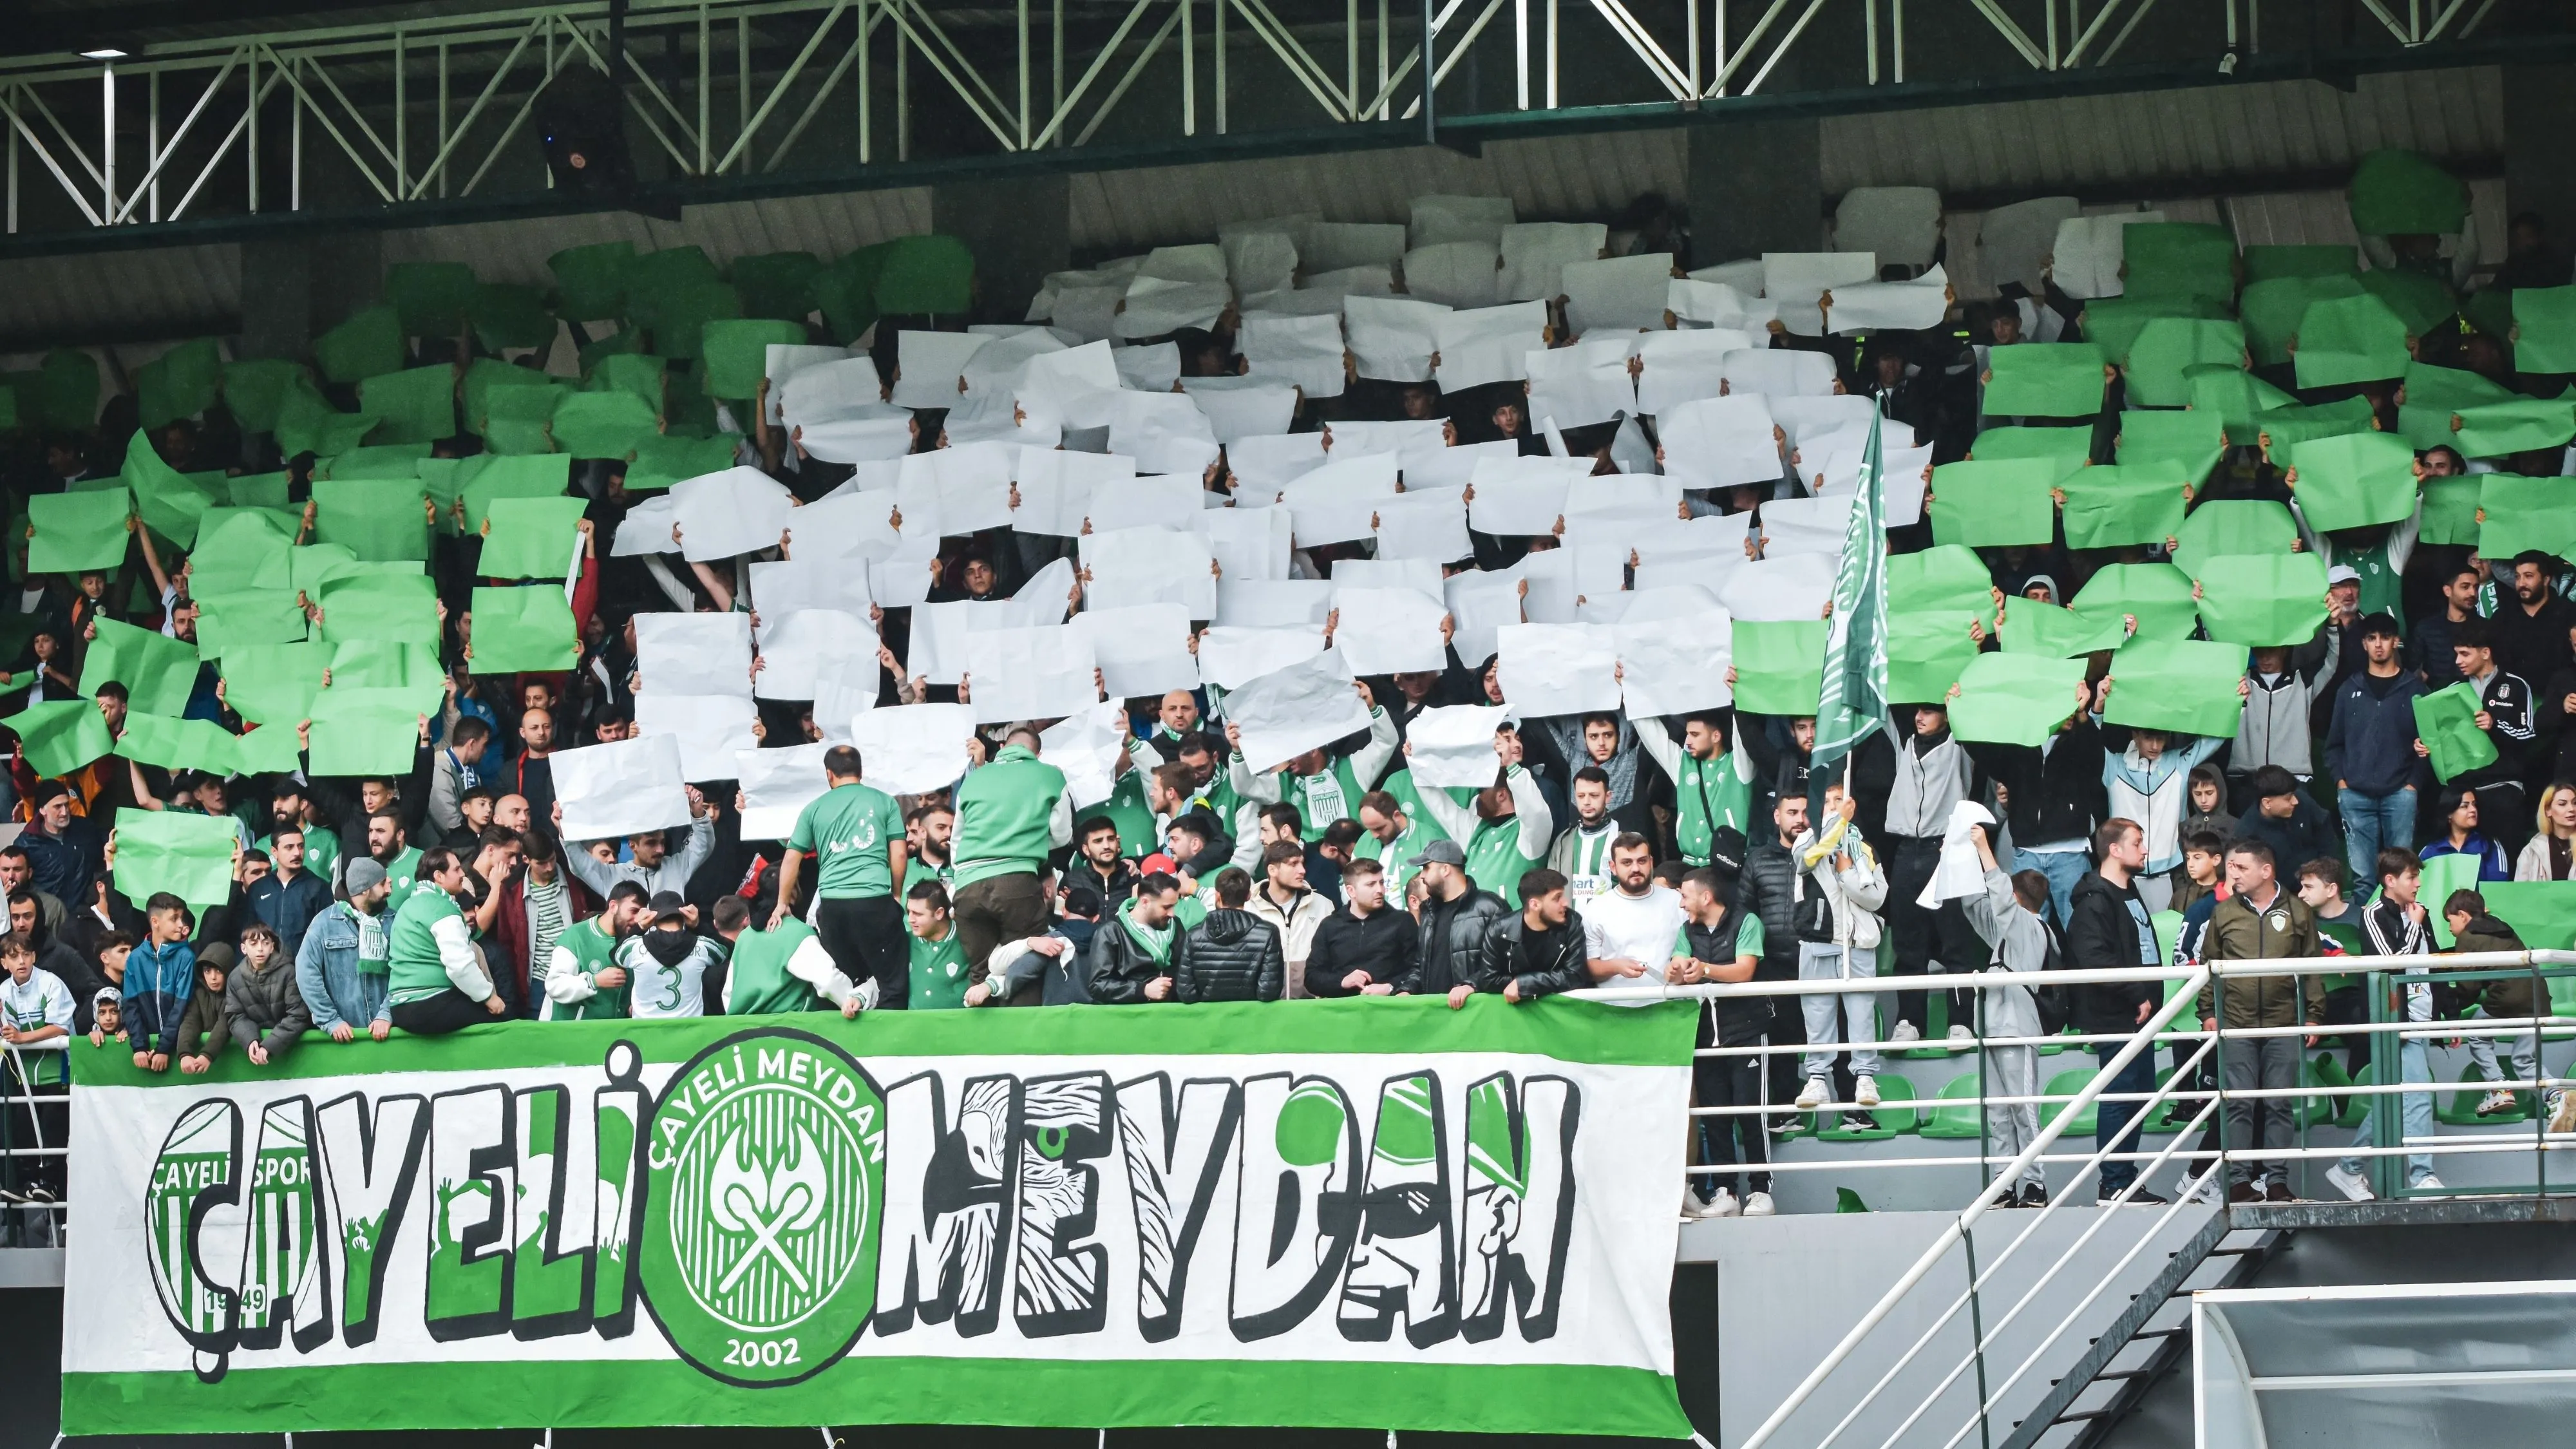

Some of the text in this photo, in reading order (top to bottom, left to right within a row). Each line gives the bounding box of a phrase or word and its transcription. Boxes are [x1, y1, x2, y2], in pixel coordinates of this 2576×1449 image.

[1572, 878, 1594, 889] art
[656, 965, 683, 1011] 3
[648, 1045, 885, 1171] ÇAYELİ MEYDAN
[151, 1153, 312, 1198] ÇAYELİ SPOR
[242, 1289, 264, 1310] 49
[723, 1338, 801, 1367] 2002
